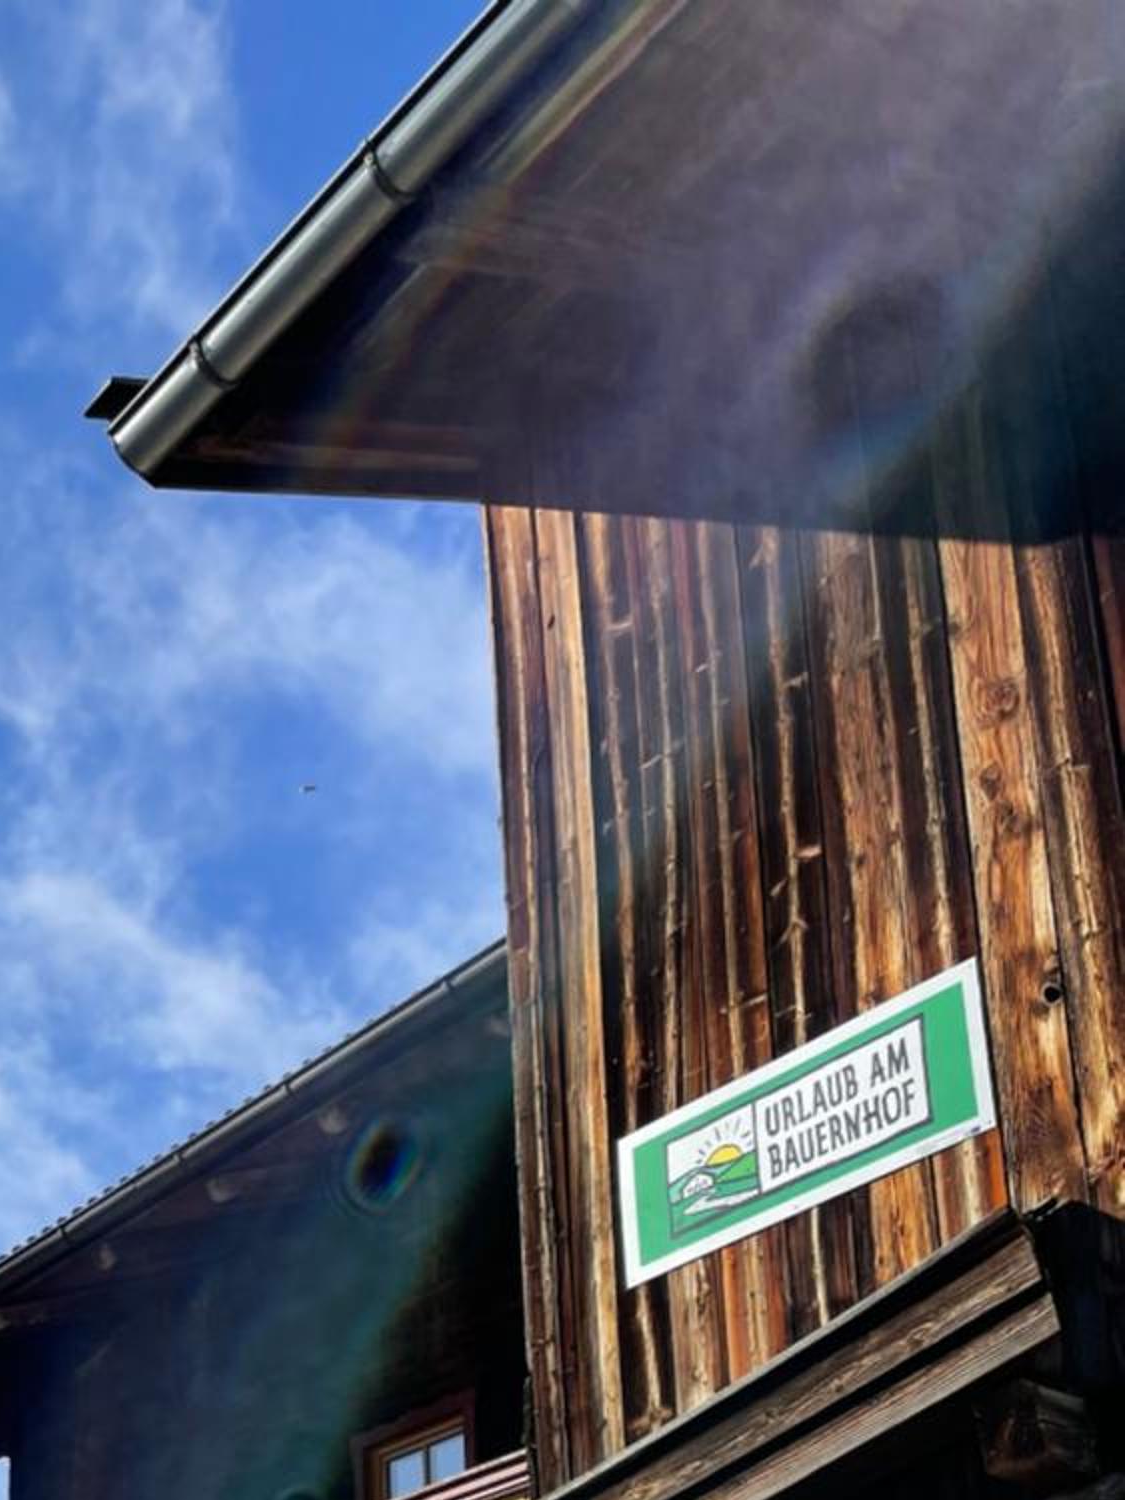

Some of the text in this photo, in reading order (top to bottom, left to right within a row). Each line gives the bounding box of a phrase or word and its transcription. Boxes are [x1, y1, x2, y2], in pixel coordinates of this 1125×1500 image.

[765, 1037, 910, 1137] URLAUB AM
[767, 1079, 915, 1179] BAUERNHOF
